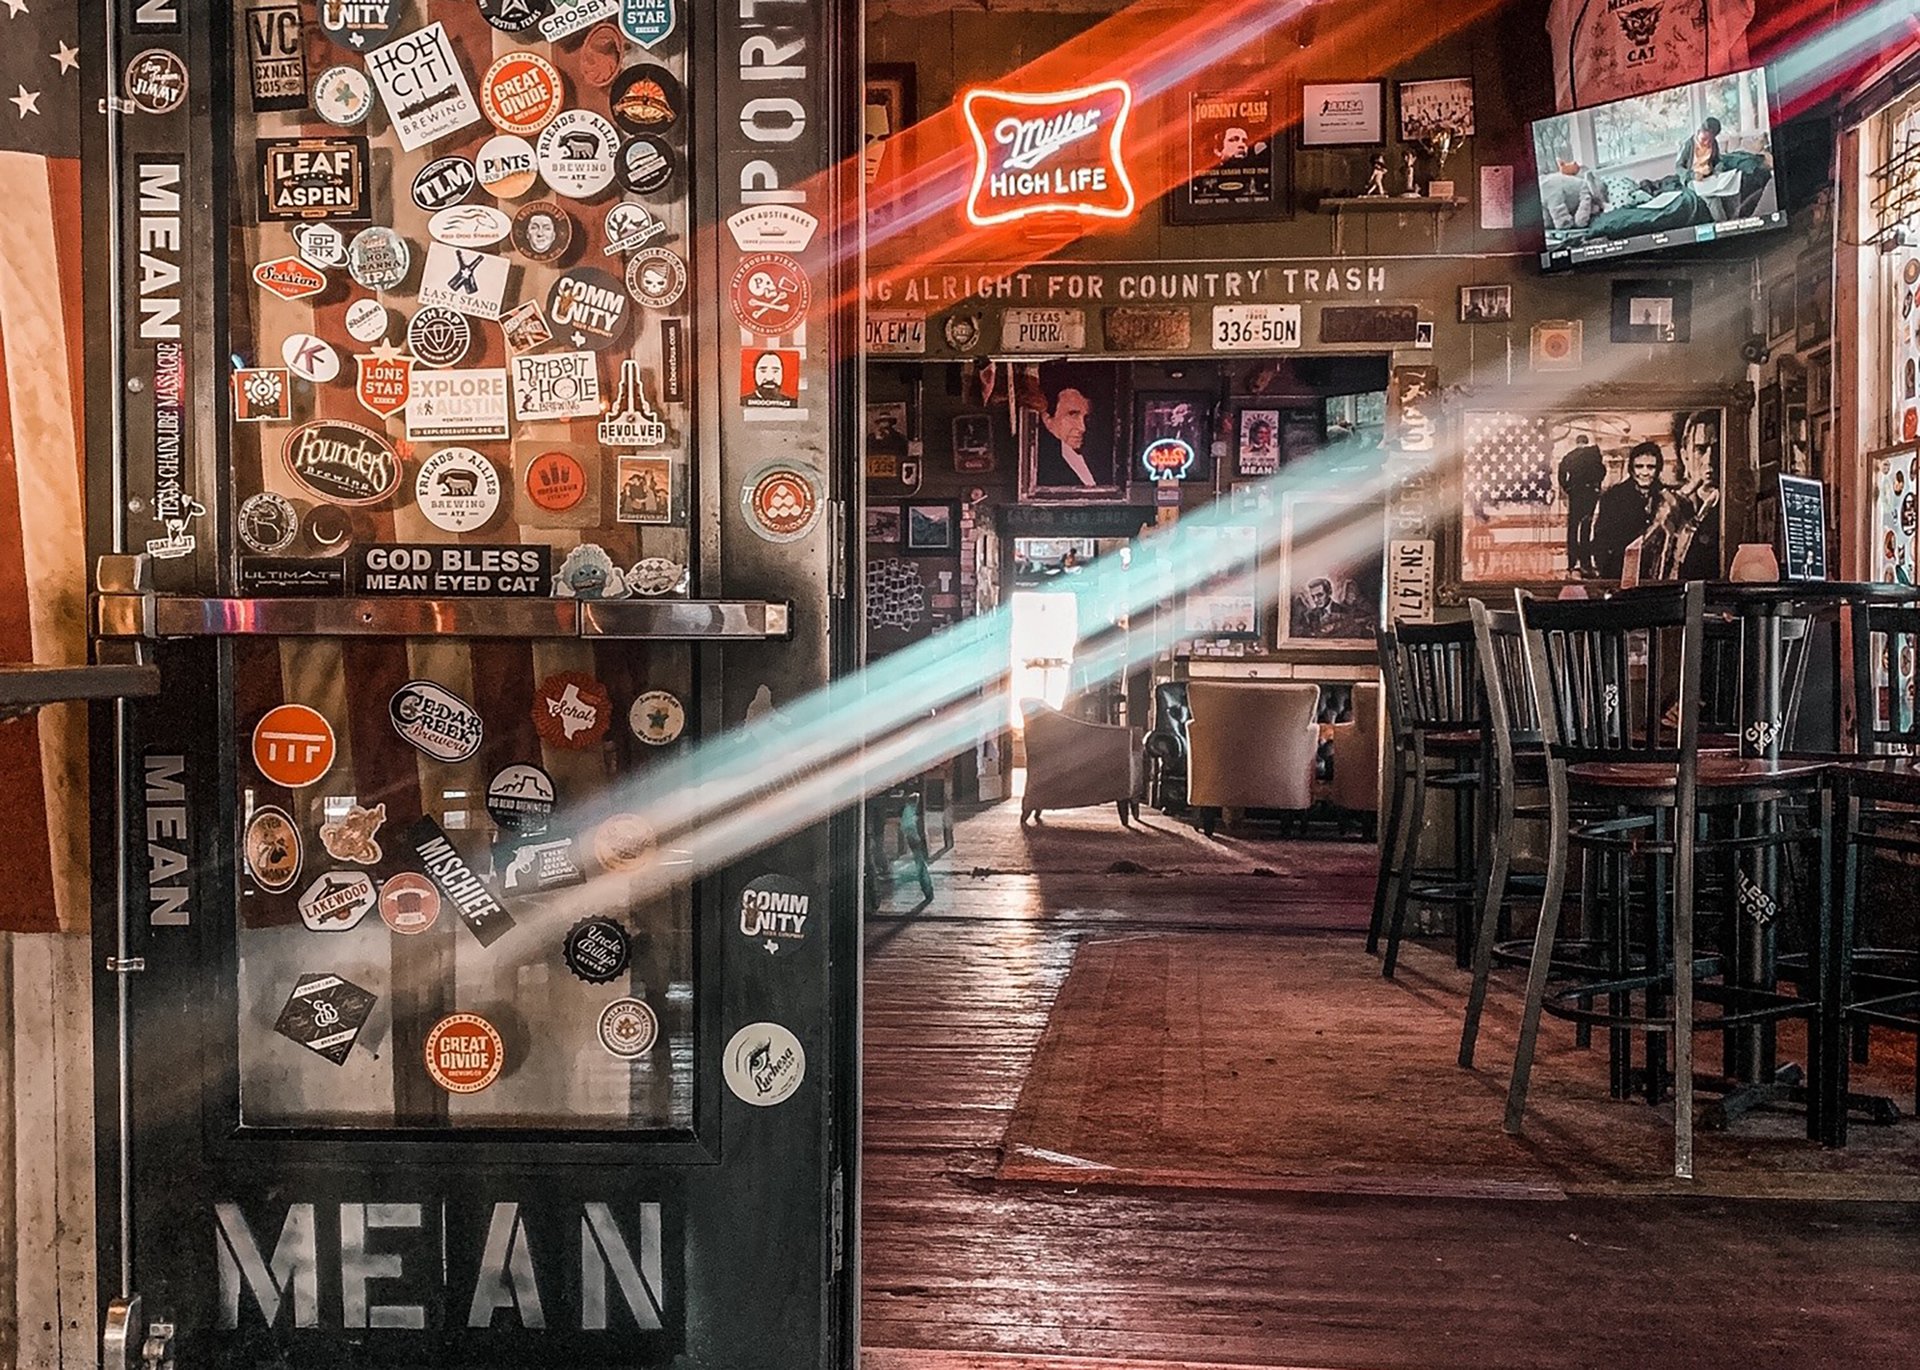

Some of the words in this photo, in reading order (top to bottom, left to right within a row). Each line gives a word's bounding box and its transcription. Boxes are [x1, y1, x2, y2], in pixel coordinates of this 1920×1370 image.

[323, 4, 391, 31] UNITY
[520, 9, 542, 29] TEXAS
[541, 0, 608, 33] CROSBY
[627, 11, 668, 25] STAR
[252, 12, 298, 56] VC
[373, 27, 453, 83] HOLY
[1626, 45, 1656, 62] CAT
[132, 77, 180, 102] JIMMY
[256, 80, 281, 93] 2015
[493, 66, 541, 102] GREAT
[499, 83, 551, 118] DIVIDE
[1195, 103, 1239, 123] JOHNNY
[1239, 101, 1268, 116] CASH
[402, 100, 468, 135] BREWING
[540, 114, 576, 159] FRIENDS
[589, 117, 618, 159] ALLIES
[995, 109, 1101, 169] Miller
[274, 151, 350, 179] LEAF
[551, 163, 607, 172] BREWING
[276, 185, 351, 207] ASPEN
[415, 162, 473, 205] TLM
[990, 171, 1049, 198] HIGH
[1055, 167, 1108, 194] LIFE
[734, 214, 756, 228] LAKE
[757, 210, 789, 220] AUSTIN
[139, 164, 181, 338] MEAN
[366, 253, 390, 263] HOP
[260, 266, 320, 288] Session
[364, 271, 398, 285] IPA
[732, 254, 773, 289] PINTHOUSE
[904, 273, 1033, 301] ALRIGHT
[1048, 274, 1104, 299] FOR
[1119, 269, 1262, 299] COUNTRY
[1283, 266, 1386, 293] TRASH
[423, 286, 456, 303] LAST
[459, 294, 499, 313] STAND
[558, 276, 626, 315] COMM
[437, 307, 461, 325] TAP
[551, 293, 620, 332] UNITY
[1026, 311, 1061, 323] TEXAS
[888, 321, 907, 343] EM
[912, 321, 921, 341] 4
[156, 342, 179, 402] MASSACRE
[366, 367, 404, 381] LONE
[519, 355, 589, 384] RABBIT
[365, 381, 404, 395] STAR
[412, 377, 503, 398] EXPLORE
[539, 372, 597, 401] HOLE
[434, 397, 504, 416] AUSTIN
[600, 424, 663, 439] REVOLVER
[295, 427, 393, 493] Founders
[419, 451, 454, 496] FRIENDS
[468, 455, 497, 496] ALLIES
[430, 500, 486, 509] BREWING
[366, 549, 433, 571] GOD
[442, 549, 540, 572] BLESS
[366, 574, 429, 591] MEAN
[435, 574, 495, 592] EYED
[497, 574, 540, 592] CAT
[410, 724, 469, 753] Brewery
[144, 755, 190, 926] MEAN
[304, 881, 369, 919] LAKEWOOD
[742, 889, 809, 914] COMM
[740, 907, 807, 936] UNITY
[587, 925, 621, 954] Uncle
[440, 1036, 489, 1053] GREAT
[440, 1053, 490, 1070] DIVIDE
[214, 1202, 664, 1329] MEAN
